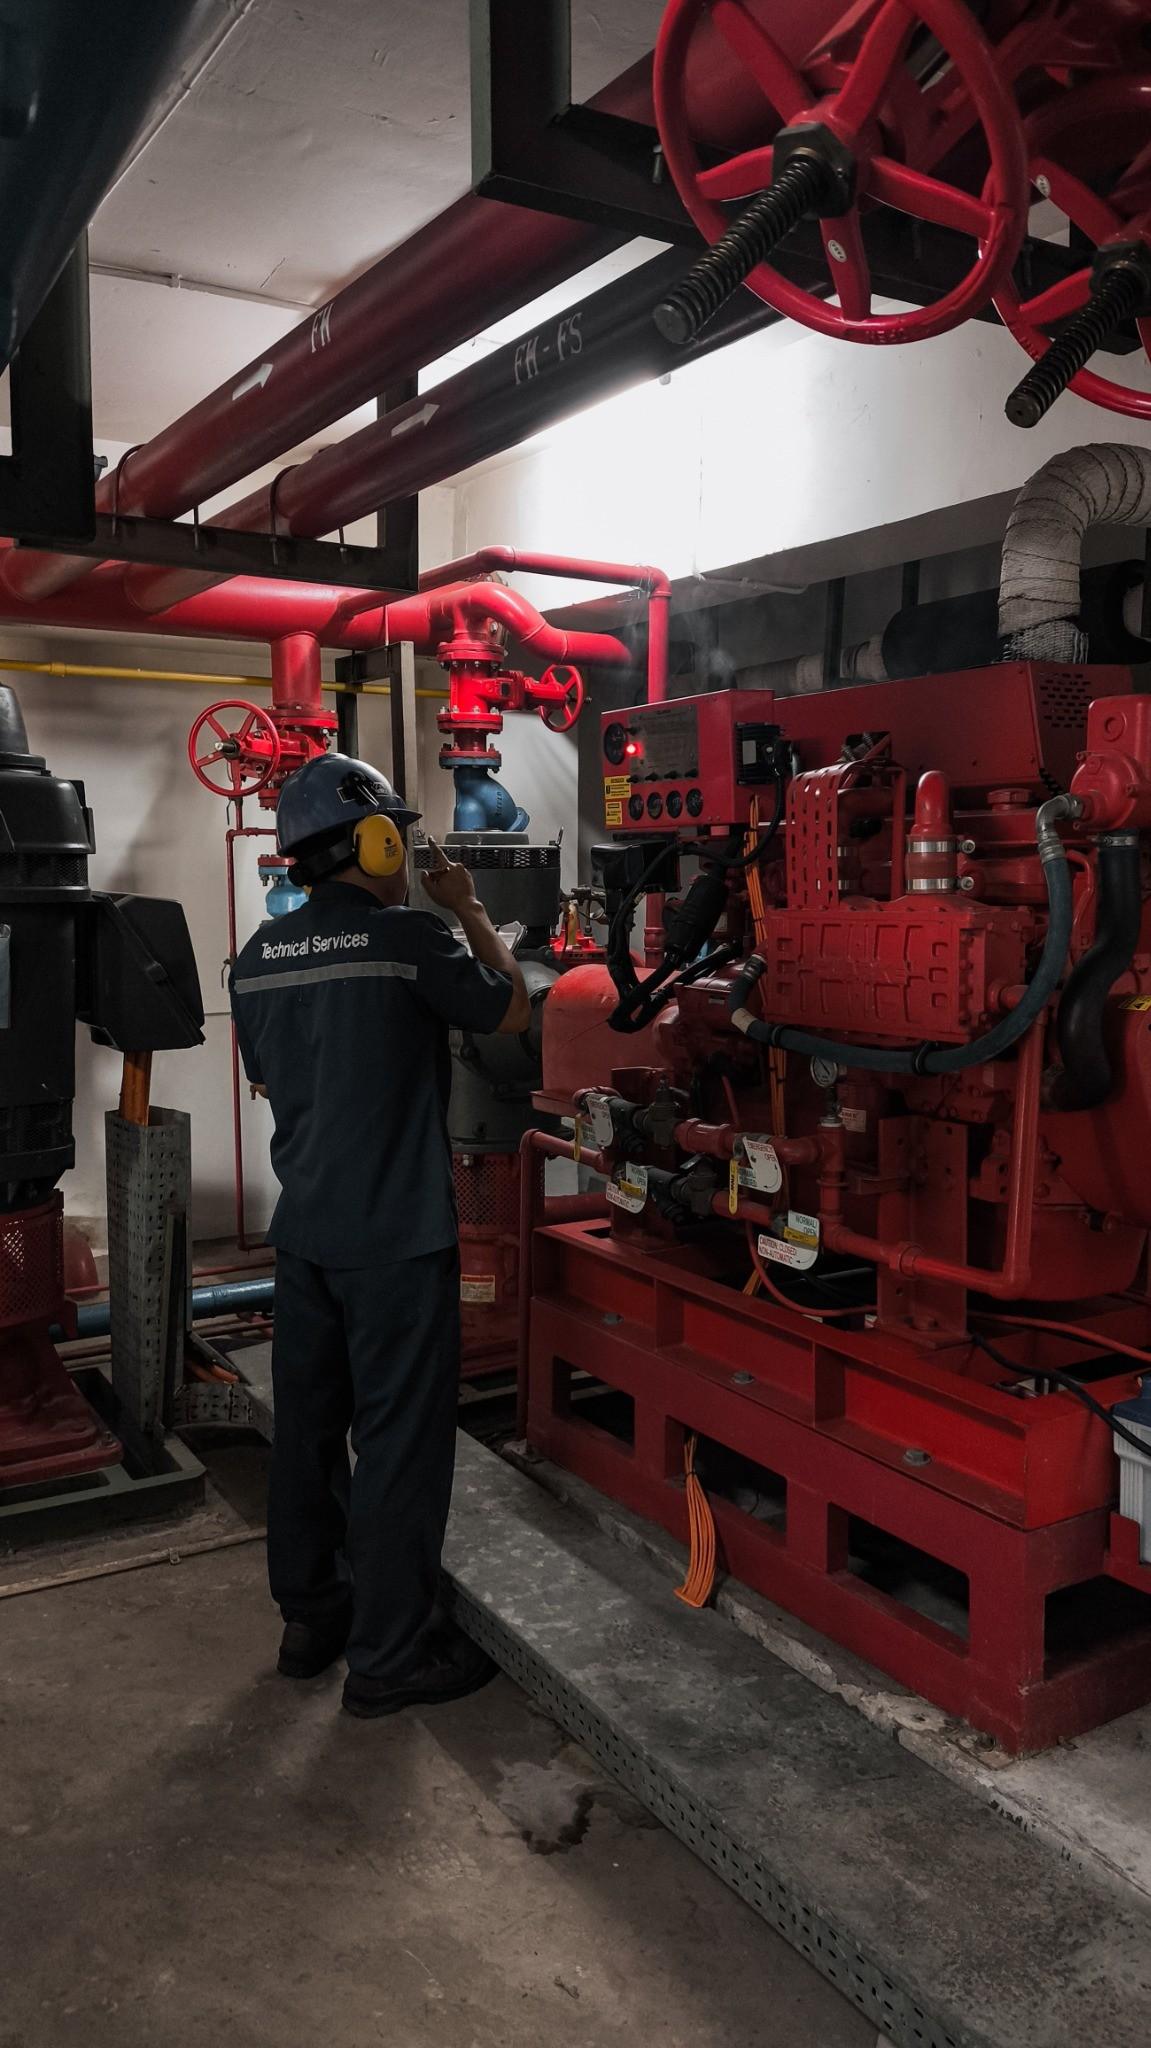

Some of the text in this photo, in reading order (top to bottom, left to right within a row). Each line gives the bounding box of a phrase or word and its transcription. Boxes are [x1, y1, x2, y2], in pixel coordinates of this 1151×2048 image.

[557, 312, 583, 361] FS
[261, 931, 370, 960] Technical Services
